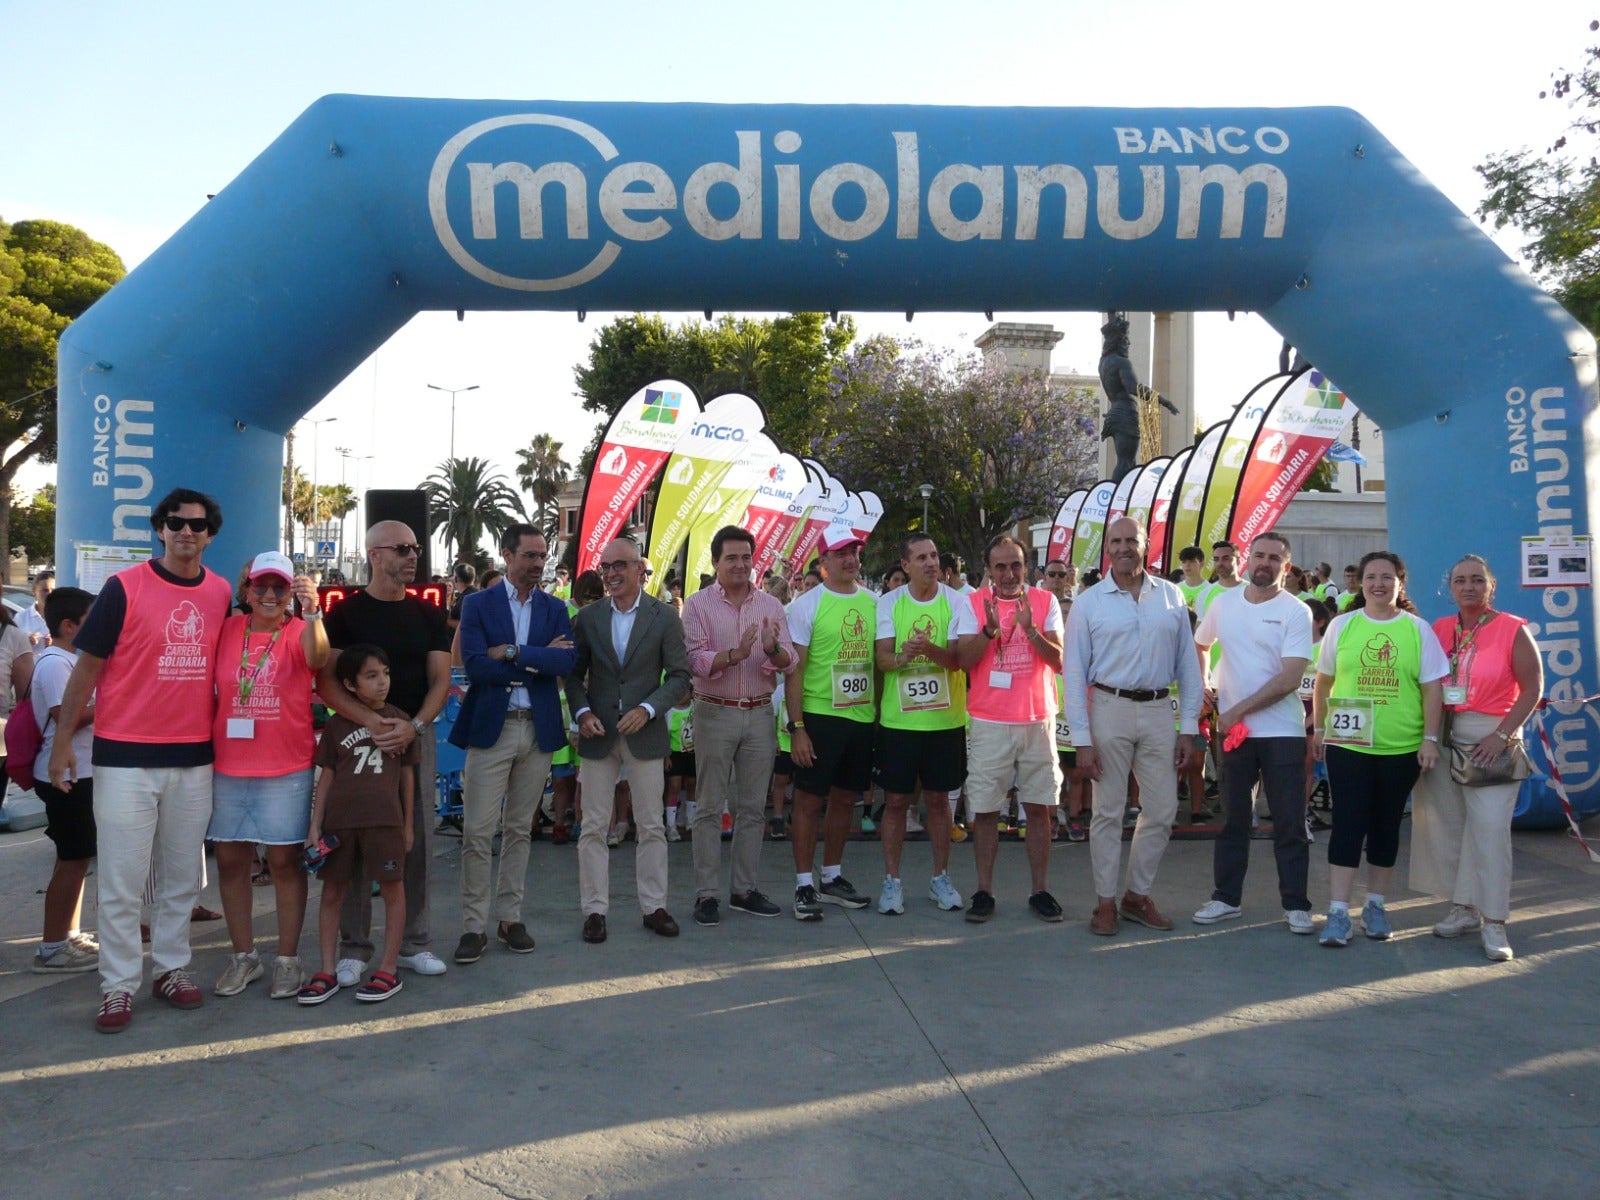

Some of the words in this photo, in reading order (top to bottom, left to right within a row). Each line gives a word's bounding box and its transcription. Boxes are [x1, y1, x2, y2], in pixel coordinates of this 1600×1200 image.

[1114, 126, 1291, 155] BANCO
[466, 130, 1290, 241] mediolanum
[92, 393, 111, 487] BANCO
[1506, 385, 1529, 475] BANCO
[586, 510, 614, 552] CARRERA
[609, 460, 648, 511] SOLIDARIA
[1238, 500, 1271, 543] CARRERA
[1265, 448, 1309, 502] SOLIDARIA
[655, 518, 682, 559] CARRERA
[676, 471, 713, 520] SOLIDARIA
[760, 523, 786, 560] SOLIDARIA
[1530, 386, 1590, 775] medionum
[158, 656, 207, 667] SOLIDARIA
[165, 645, 202, 656] CARRERA
[842, 677, 868, 693] 980
[1357, 676, 1399, 688] SOLIDARIA
[1361, 668, 1396, 678] CARRERA
[908, 680, 939, 697] 530
[1333, 714, 1362, 730] 231
[354, 745, 384, 774] 74
